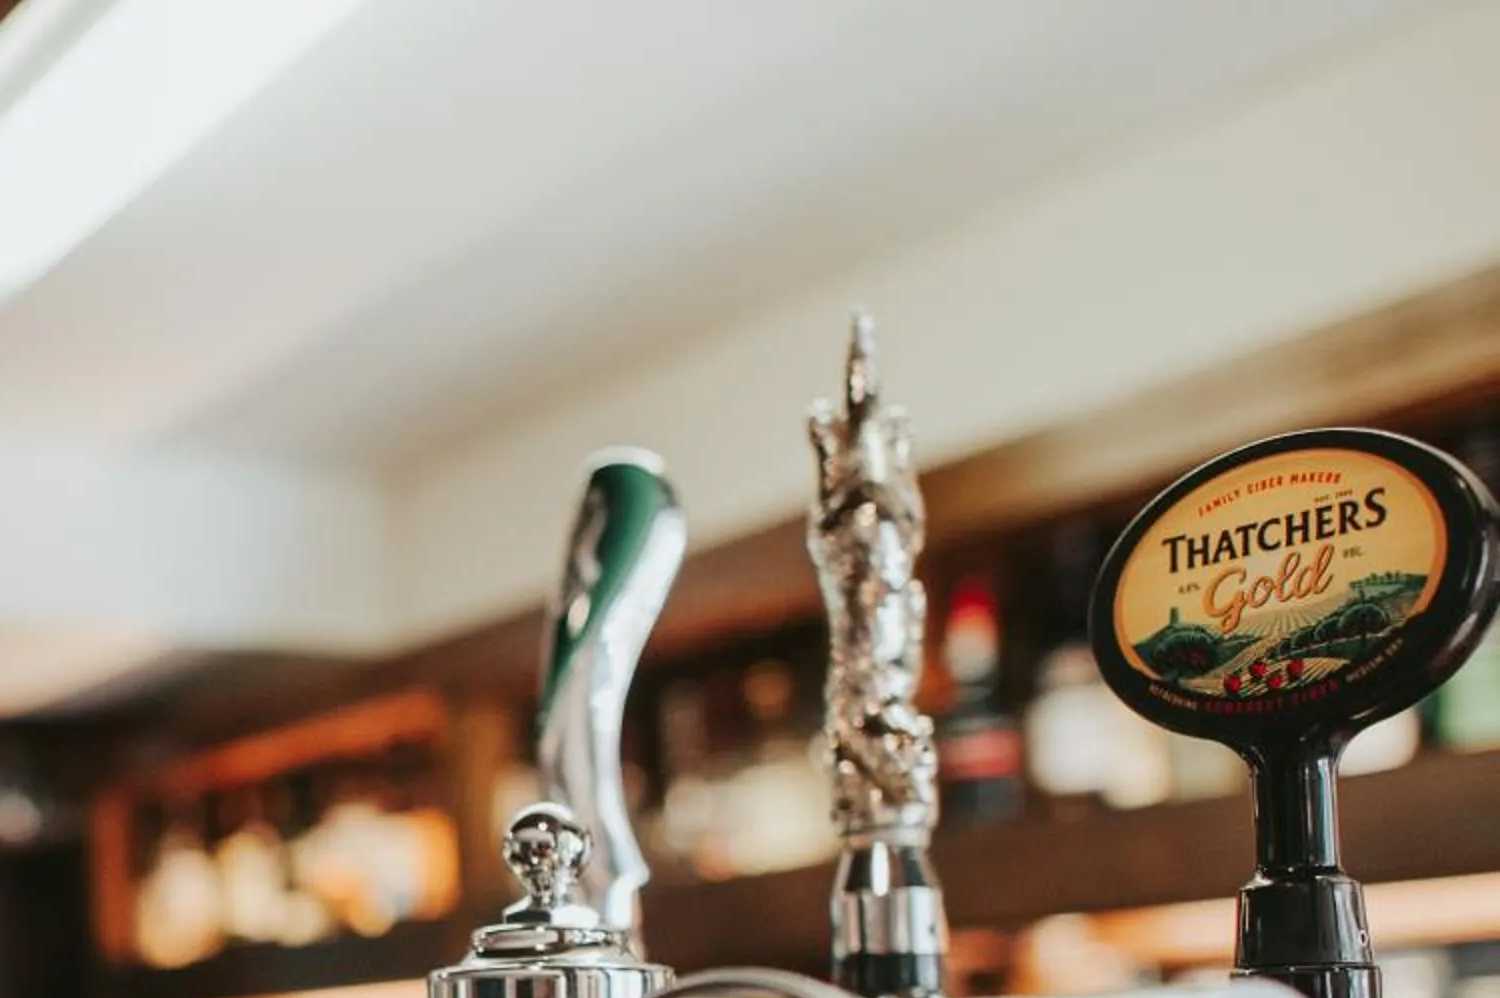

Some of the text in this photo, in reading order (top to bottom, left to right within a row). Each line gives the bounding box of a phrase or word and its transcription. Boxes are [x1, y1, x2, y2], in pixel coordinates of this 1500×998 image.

[1162, 487, 1387, 573] THATCHERS
[1198, 489, 1241, 517] FAMILY
[1202, 543, 1336, 636] Gold
